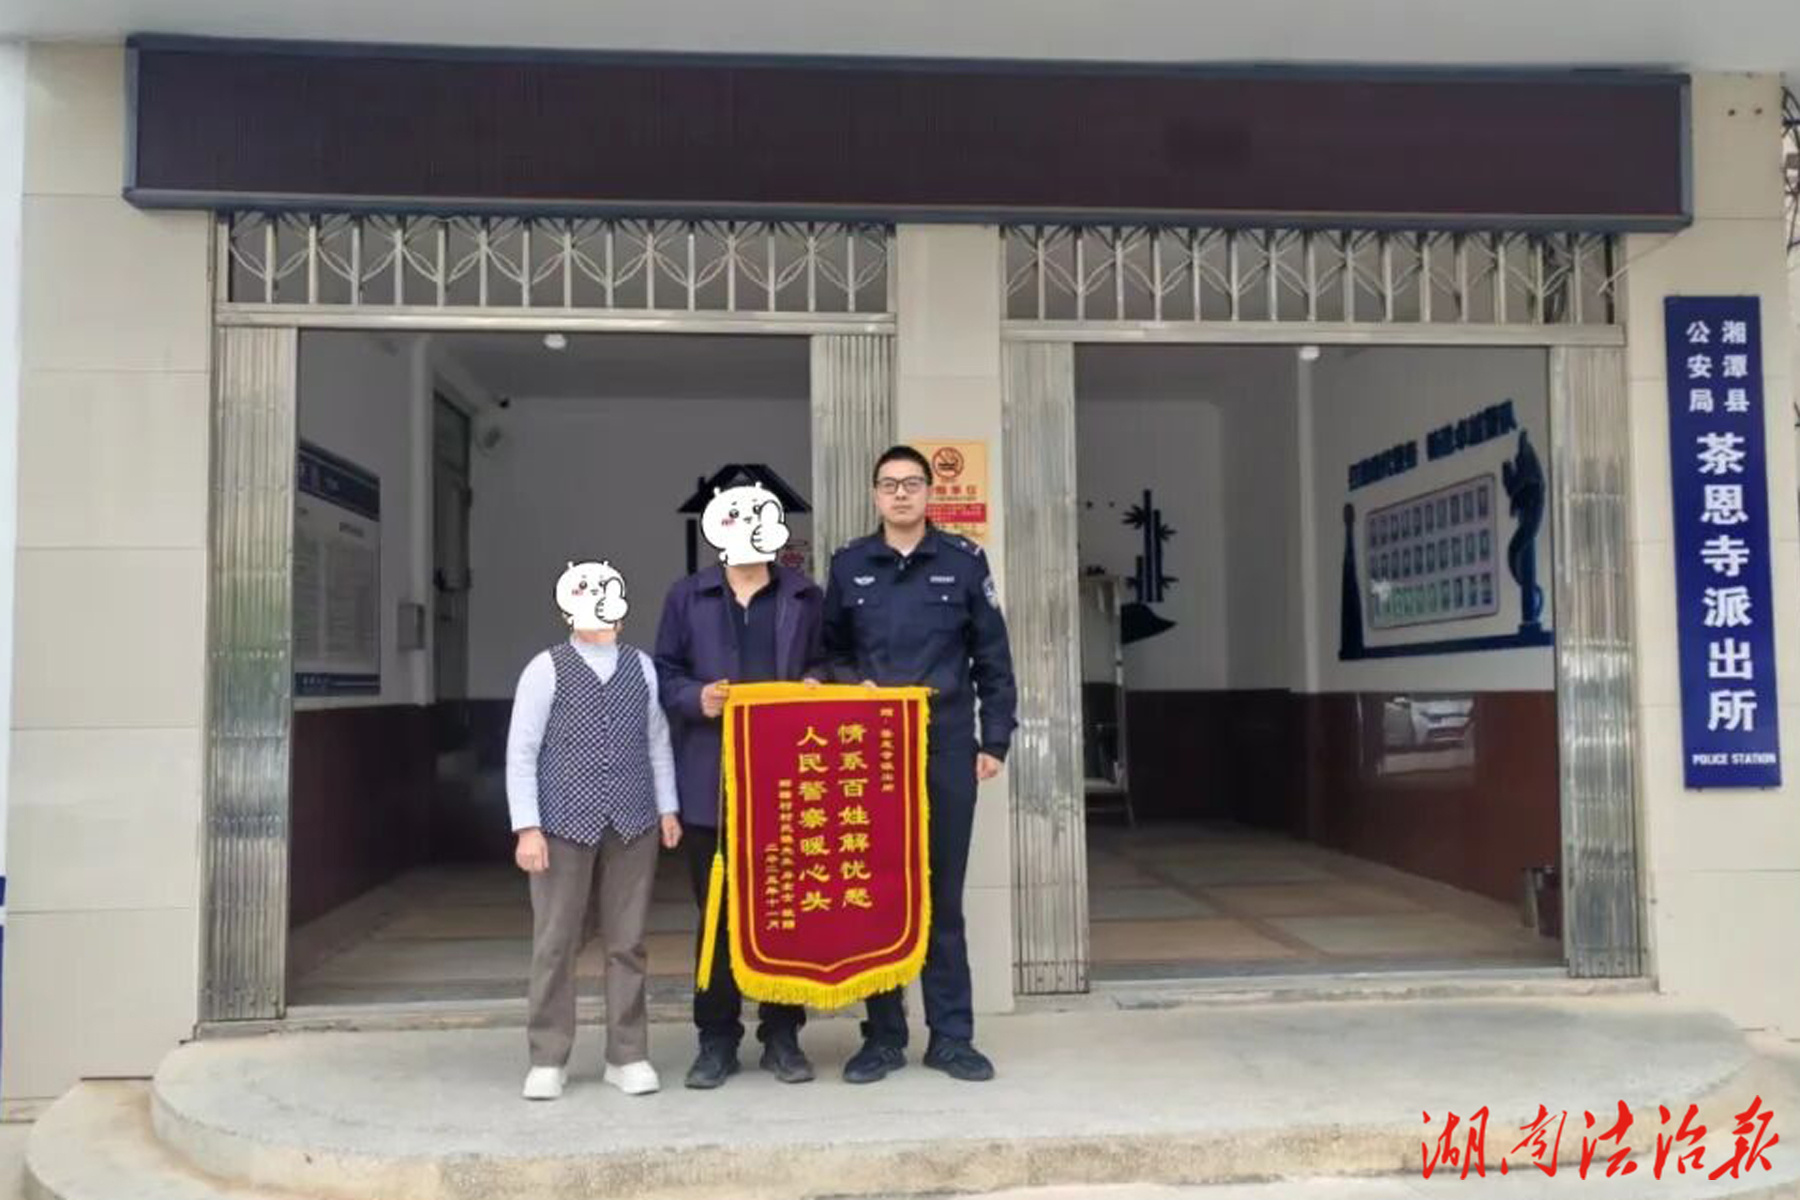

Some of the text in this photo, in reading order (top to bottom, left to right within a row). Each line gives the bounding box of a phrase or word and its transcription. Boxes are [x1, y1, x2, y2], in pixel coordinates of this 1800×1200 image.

[1686, 320, 1714, 413] 公安局
[1722, 320, 1750, 412] 湘潭县
[1696, 433, 1758, 732] 茶恩寺派出所
[797, 726, 831, 911] 人民警察暖心头
[838, 723, 873, 909] 情系百姓解忧愁
[1692, 752, 1776, 765] POLICE STATION
